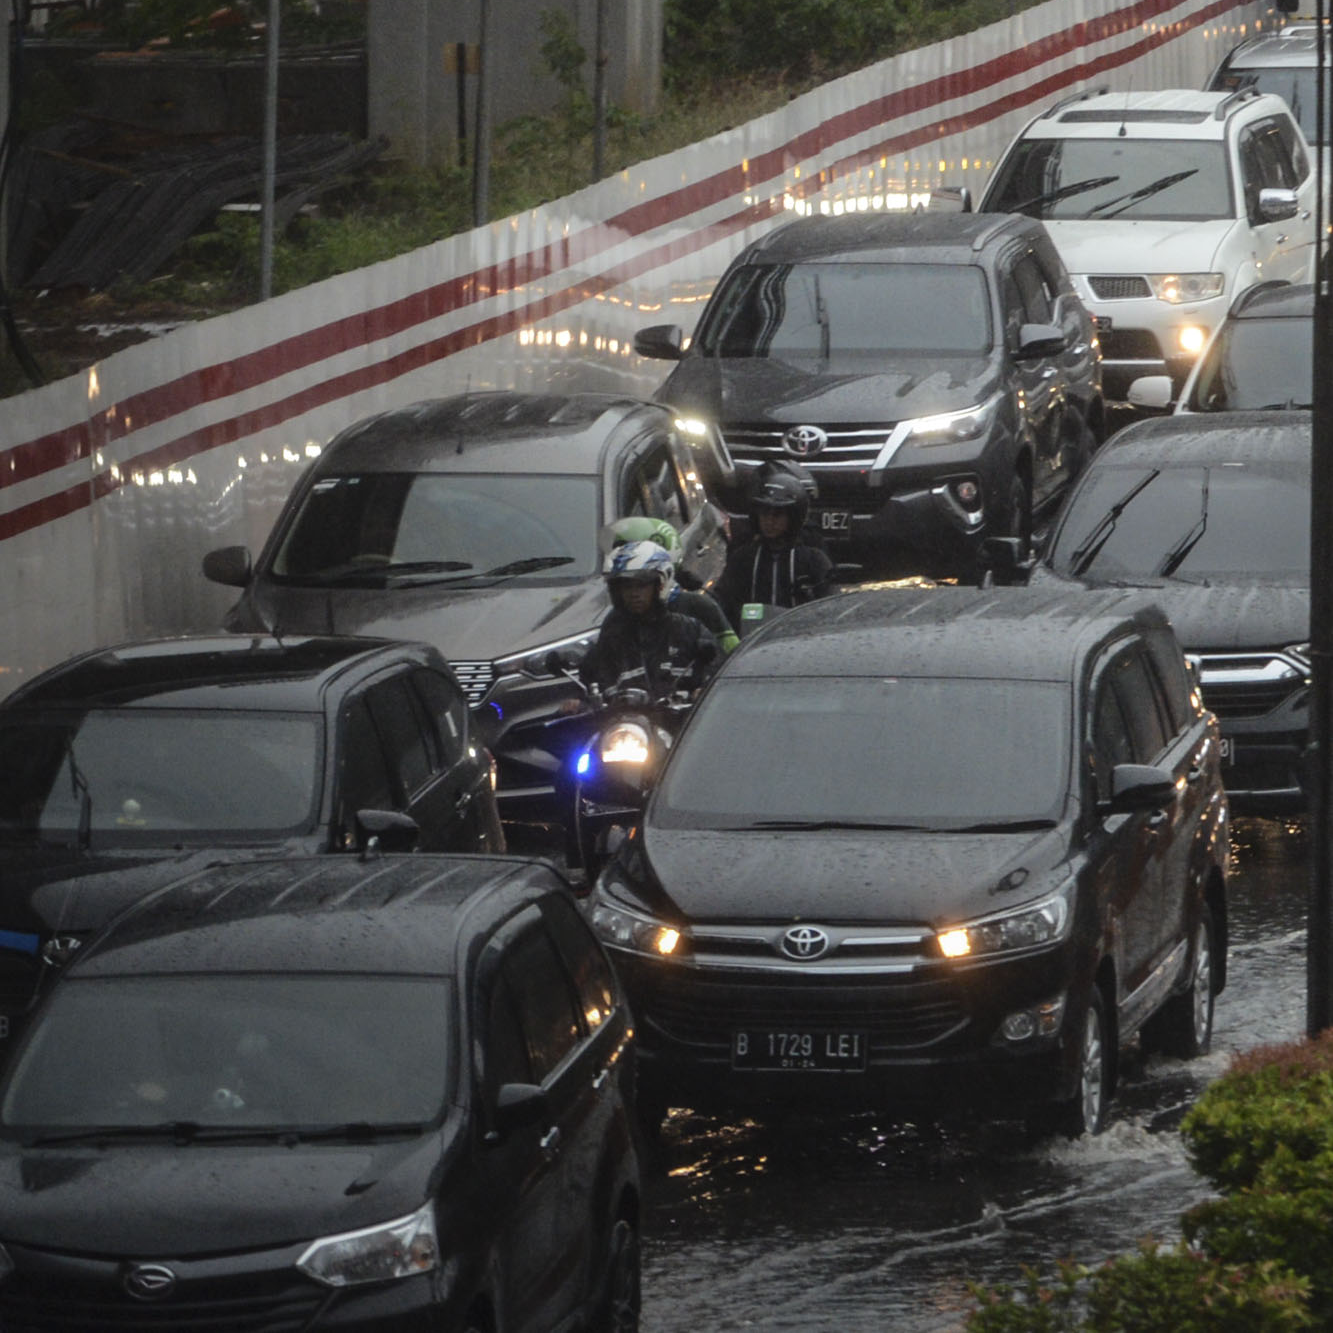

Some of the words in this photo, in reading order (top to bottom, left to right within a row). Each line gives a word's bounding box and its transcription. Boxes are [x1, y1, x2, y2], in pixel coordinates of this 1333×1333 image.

[822, 512, 848, 530] DEZ
[736, 1033, 748, 1055] B
[768, 1034, 813, 1056] 1729
[825, 1034, 860, 1057] LEI
